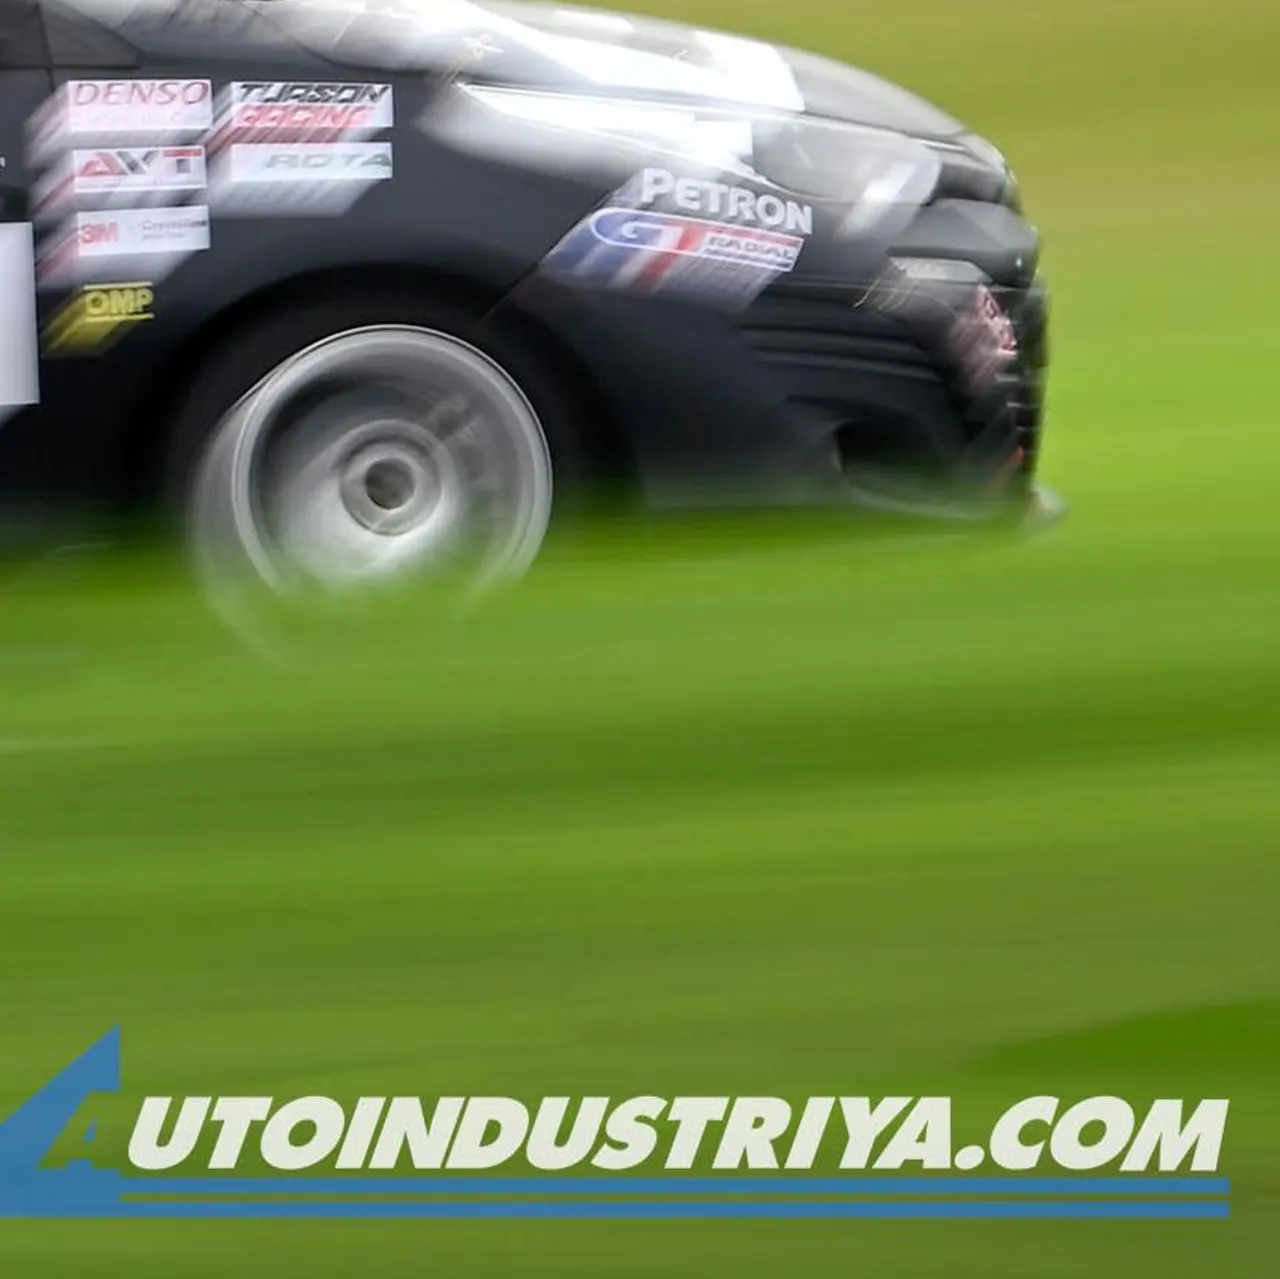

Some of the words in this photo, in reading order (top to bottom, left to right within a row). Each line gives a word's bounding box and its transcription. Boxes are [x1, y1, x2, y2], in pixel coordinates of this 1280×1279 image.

[75, 81, 209, 106] DENSO
[642, 168, 812, 234] PETRON
[80, 222, 119, 244] 3M
[85, 287, 153, 315] OMP
